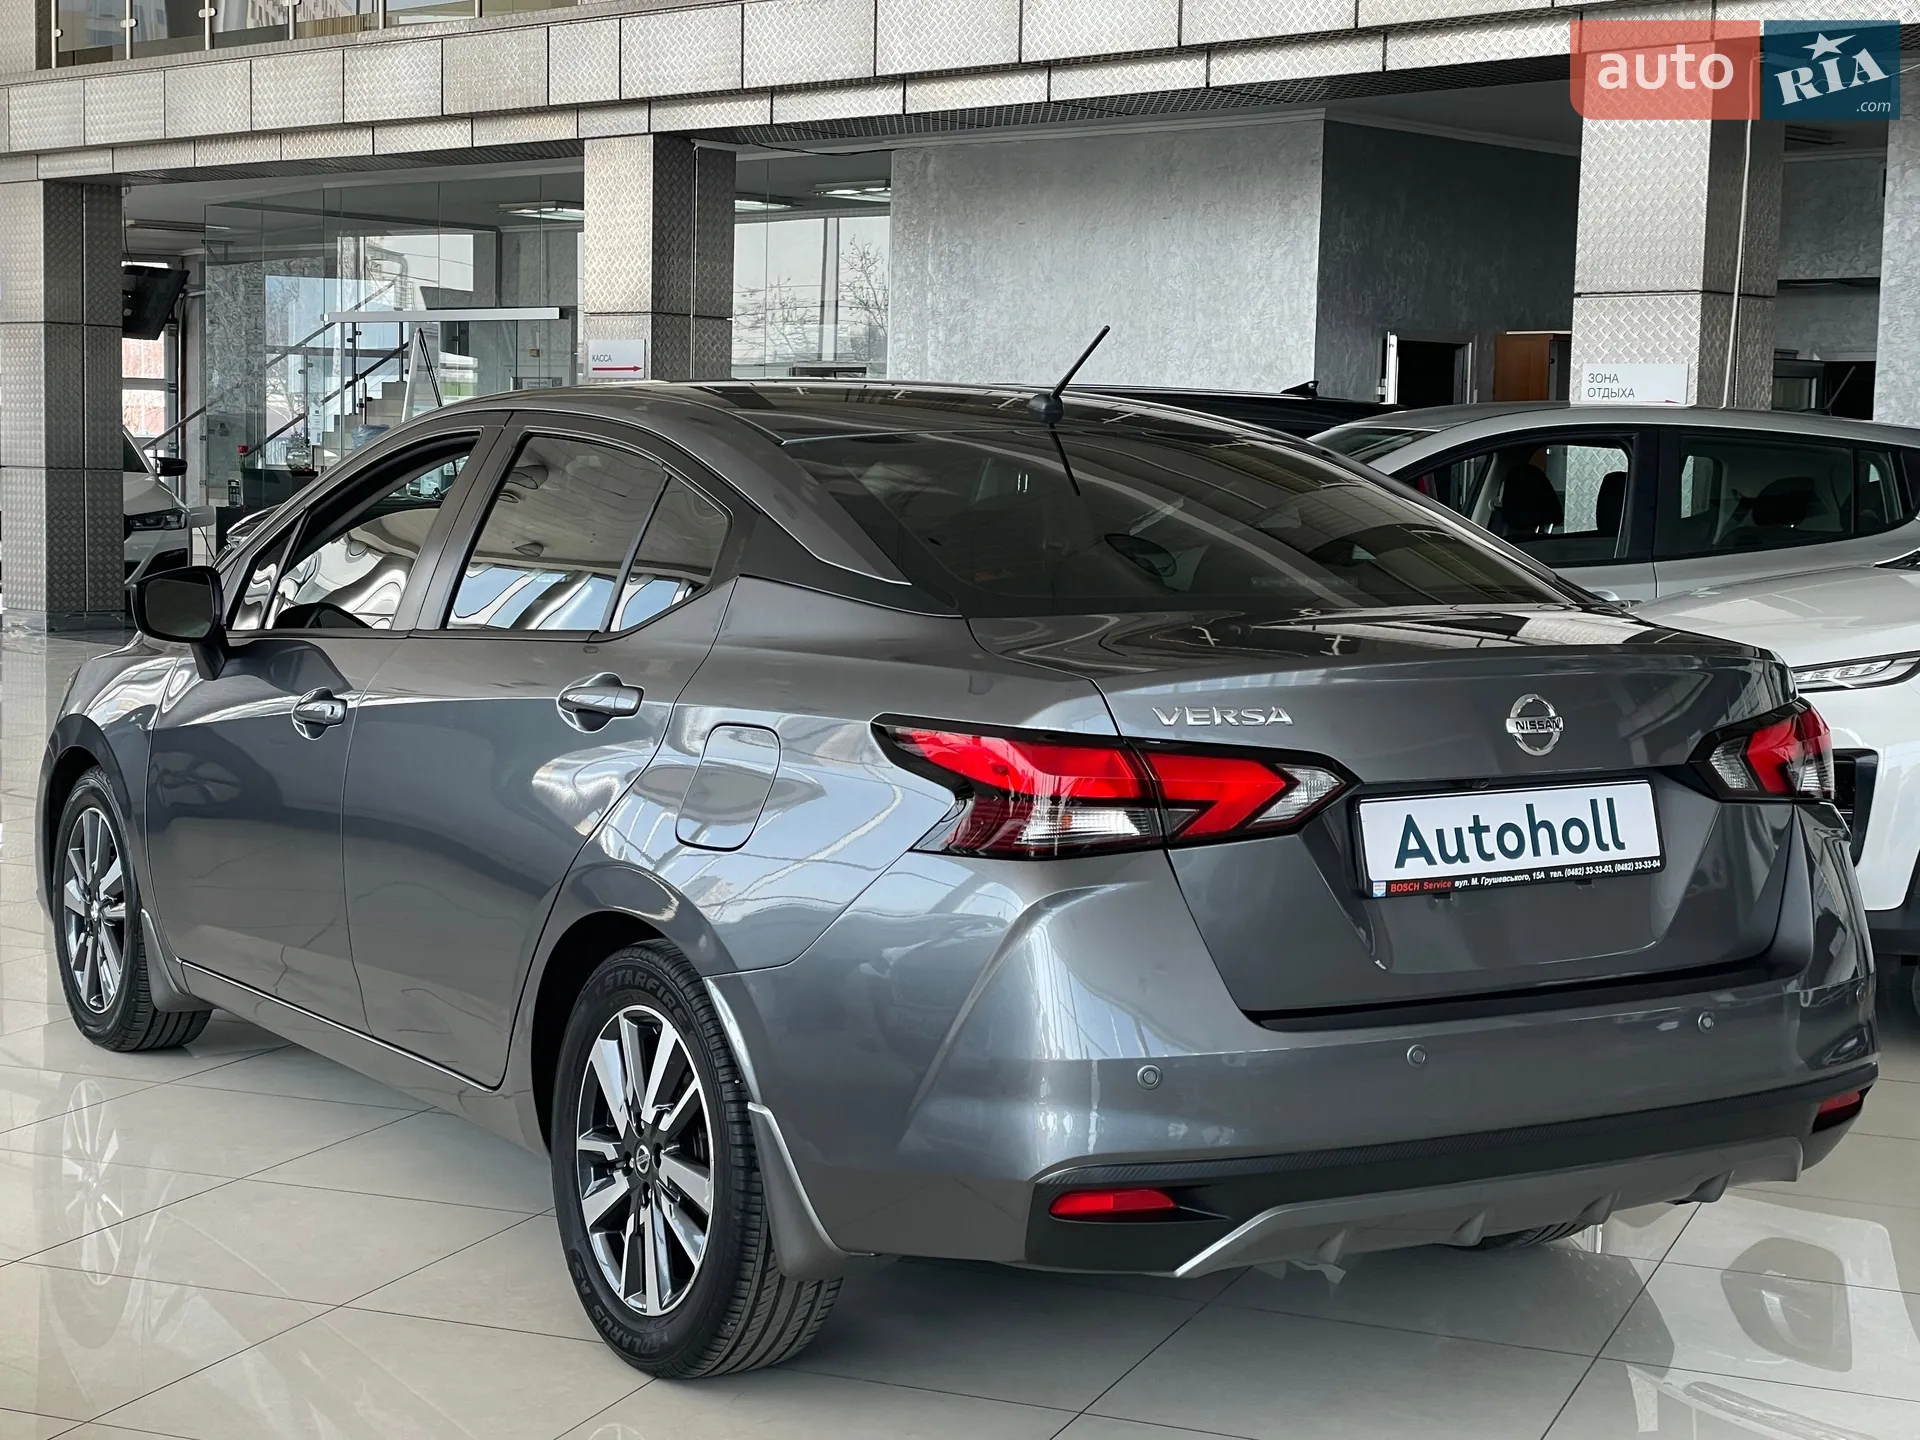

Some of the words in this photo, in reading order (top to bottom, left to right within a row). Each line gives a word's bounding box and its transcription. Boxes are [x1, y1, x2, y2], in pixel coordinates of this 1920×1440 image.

[592, 354, 613, 363] КАССА
[1588, 373, 1620, 384] ЗОНА
[1587, 387, 1636, 400] ОТДЫХА
[1152, 705, 1294, 727] VERSA
[1515, 719, 1562, 731] NISSAN
[1393, 797, 1627, 870] Autoholl
[1454, 879, 1470, 889] вул.
[1471, 877, 1479, 886] М.
[1532, 871, 1546, 880] 15А
[1549, 870, 1564, 879] тел.
[1390, 881, 1420, 893] BOSCH
[1423, 880, 1452, 891] Service
[604, 969, 688, 1026] STARFIRE
